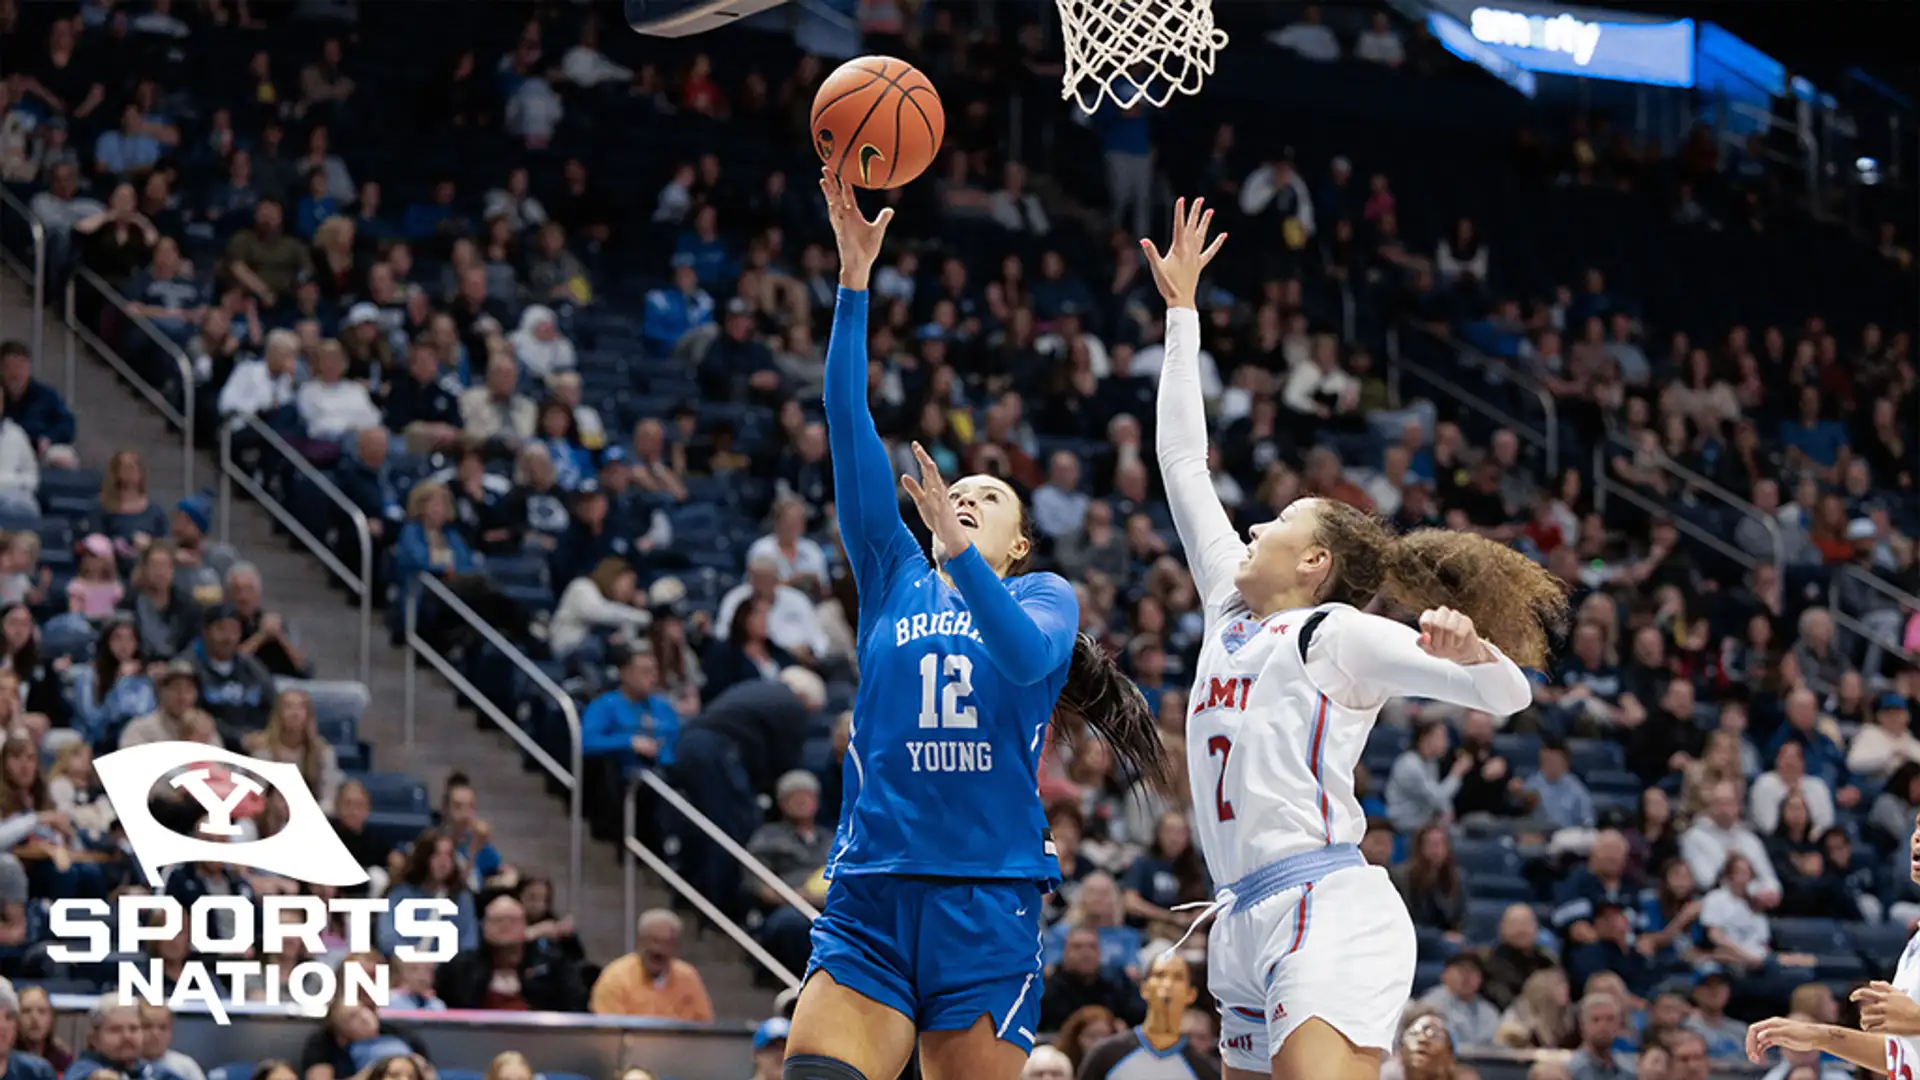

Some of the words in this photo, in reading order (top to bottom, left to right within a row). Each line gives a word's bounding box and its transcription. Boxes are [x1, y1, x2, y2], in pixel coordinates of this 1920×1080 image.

[895, 611, 984, 648] BRIGH
[918, 652, 978, 729] 12
[905, 741, 993, 772] YOUNG
[1207, 734, 1235, 823] 2
